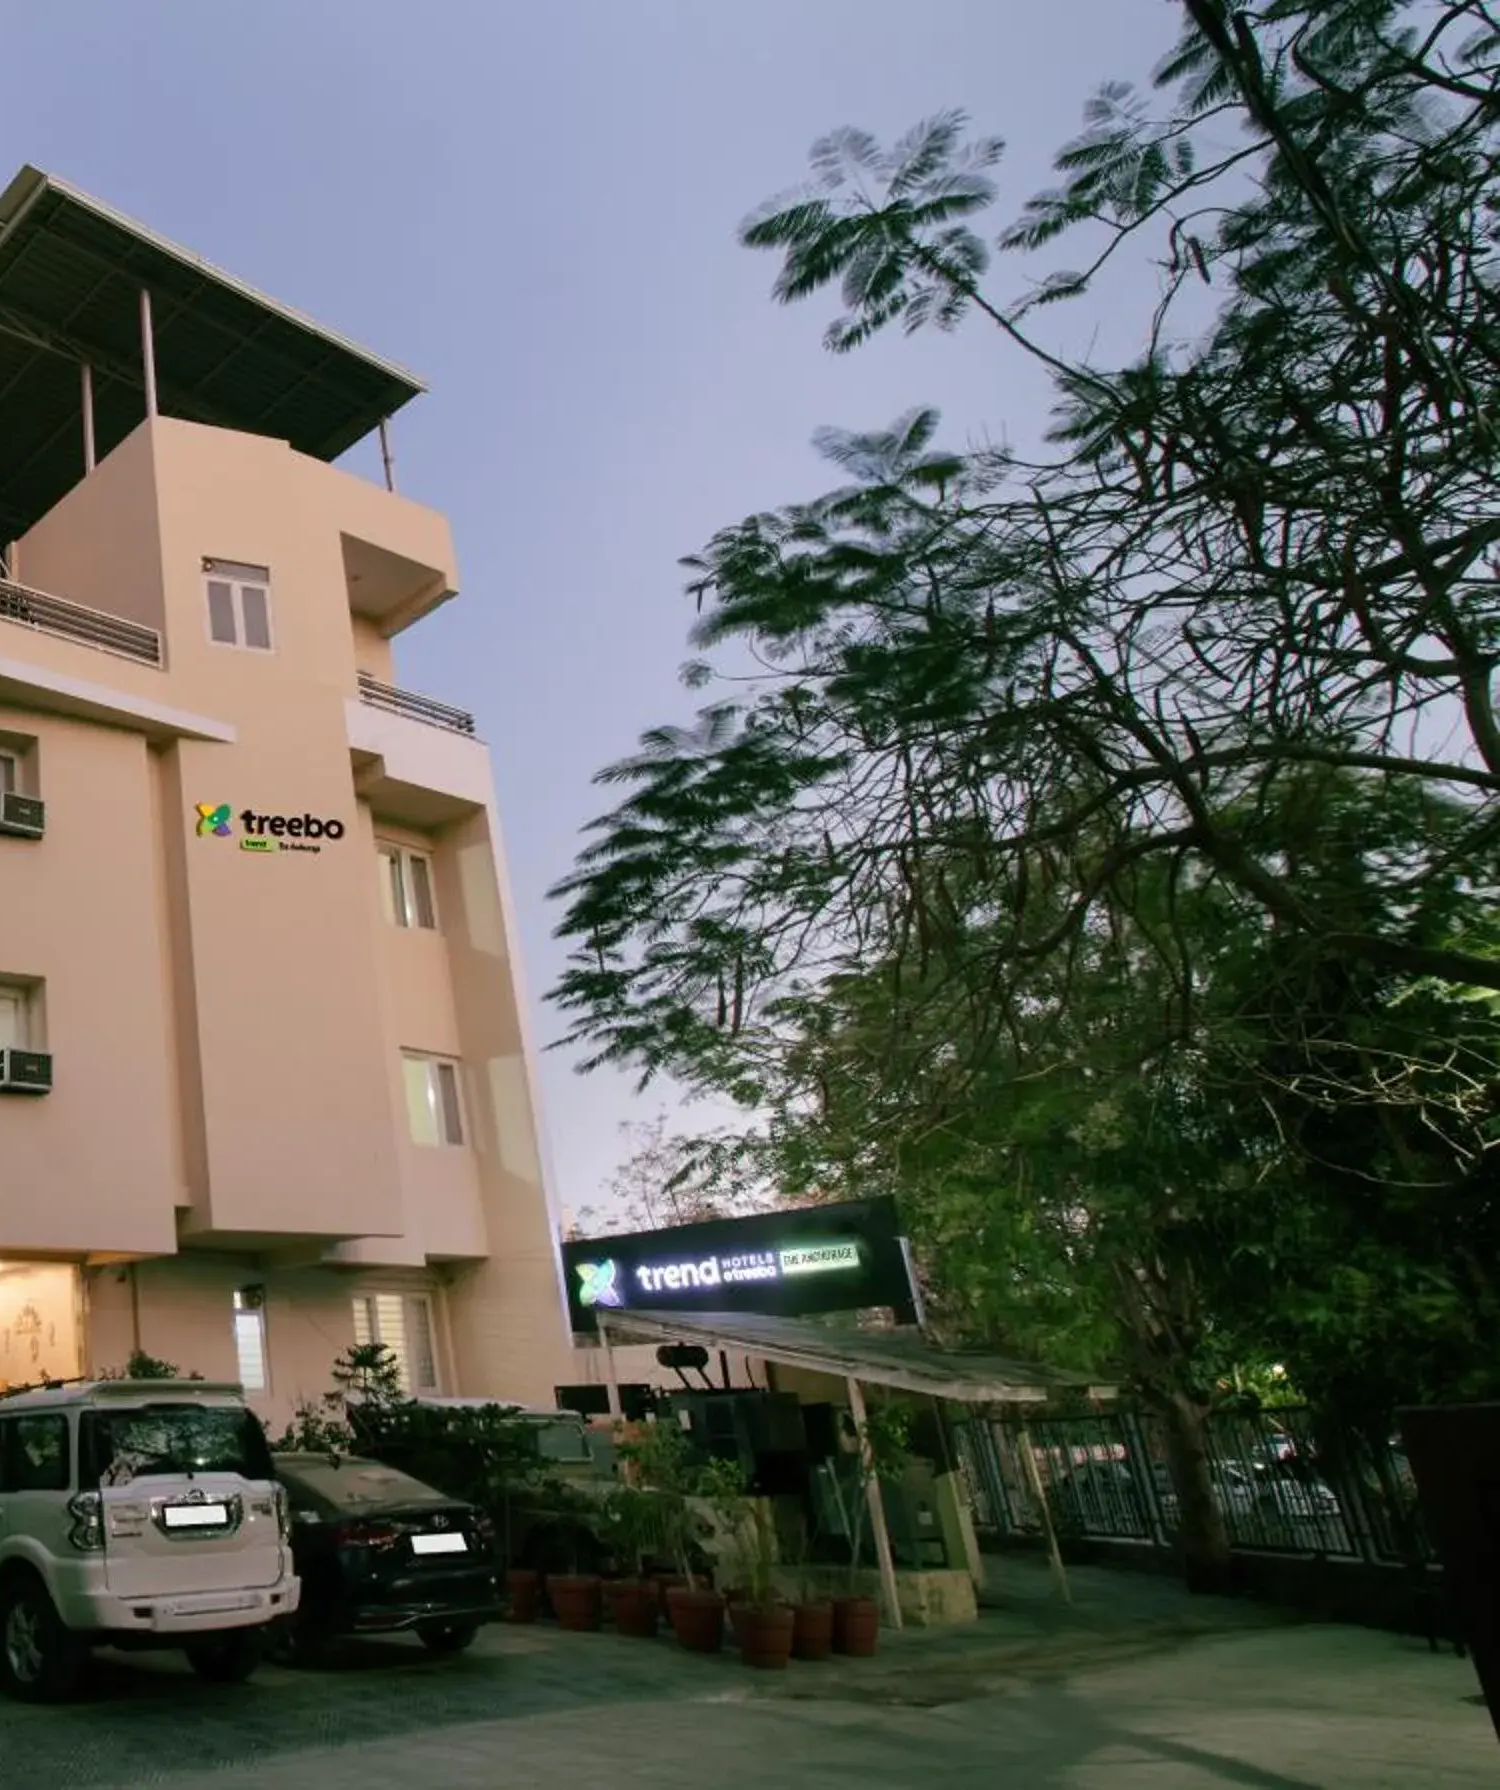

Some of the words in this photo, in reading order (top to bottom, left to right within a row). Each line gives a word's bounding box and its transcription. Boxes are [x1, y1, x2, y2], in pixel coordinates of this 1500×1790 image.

[240, 809, 345, 840] treebo
[635, 1256, 721, 1292] trend
[722, 1252, 775, 1269] HOTELS
